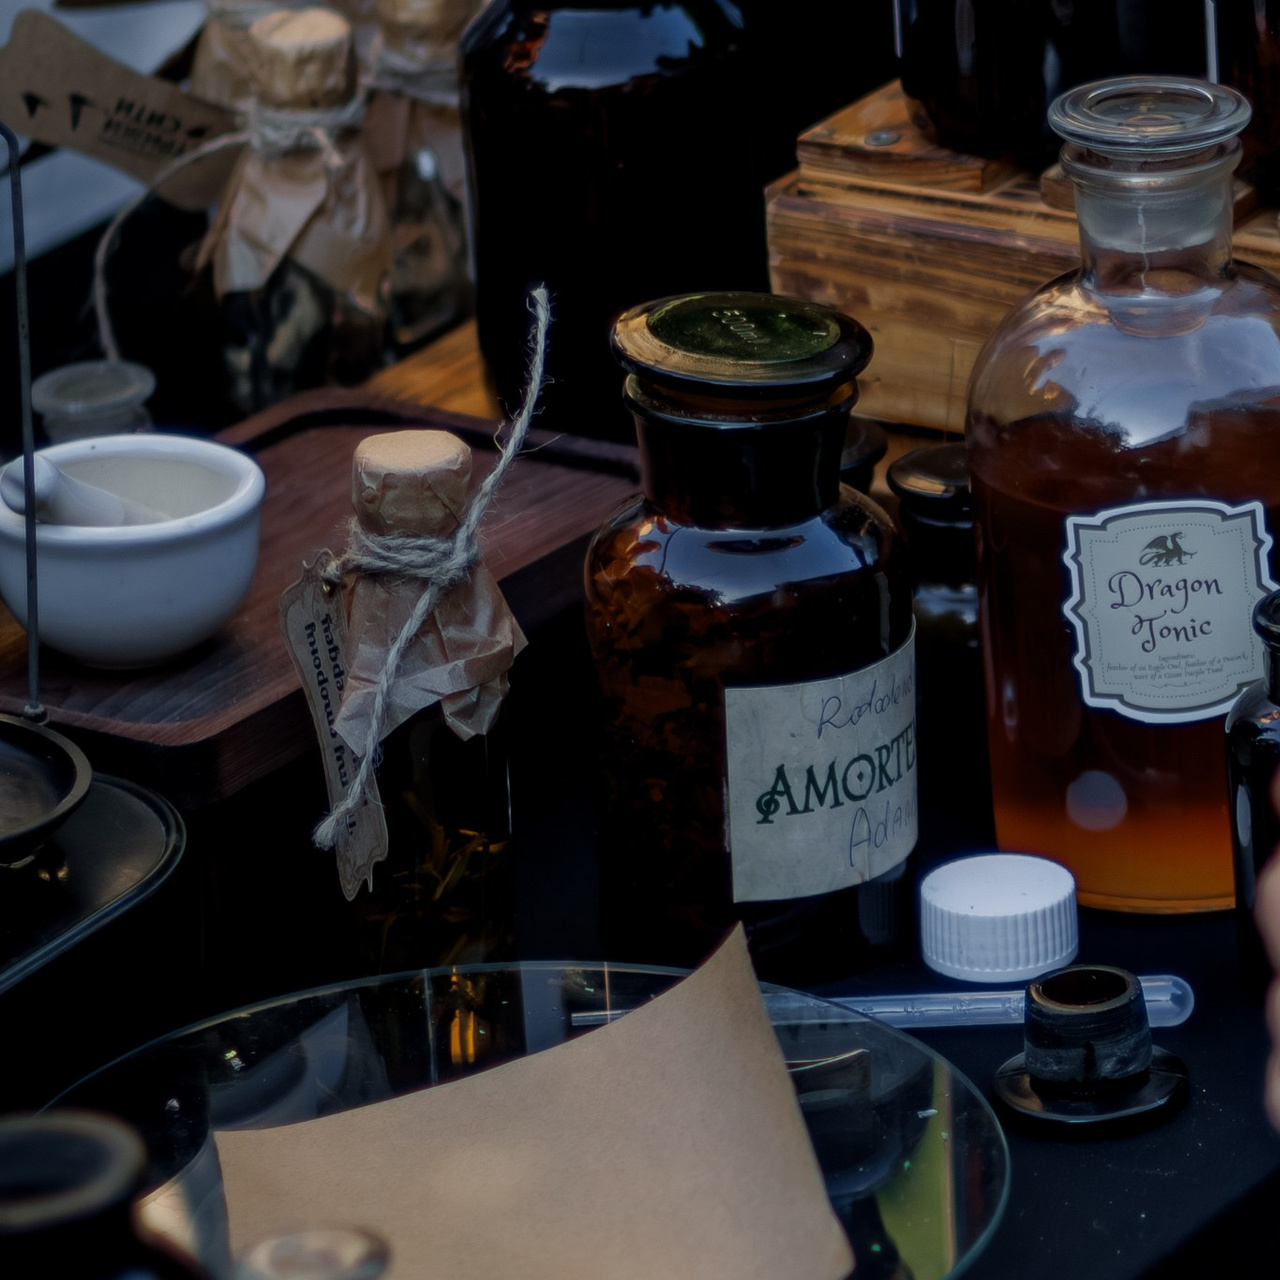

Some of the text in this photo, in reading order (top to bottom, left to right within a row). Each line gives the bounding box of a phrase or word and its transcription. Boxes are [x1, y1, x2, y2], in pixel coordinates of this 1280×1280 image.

[1108, 571, 1223, 614] Dragon
[1131, 609, 1213, 653] Tonic
[756, 718, 916, 825] AMORTE
